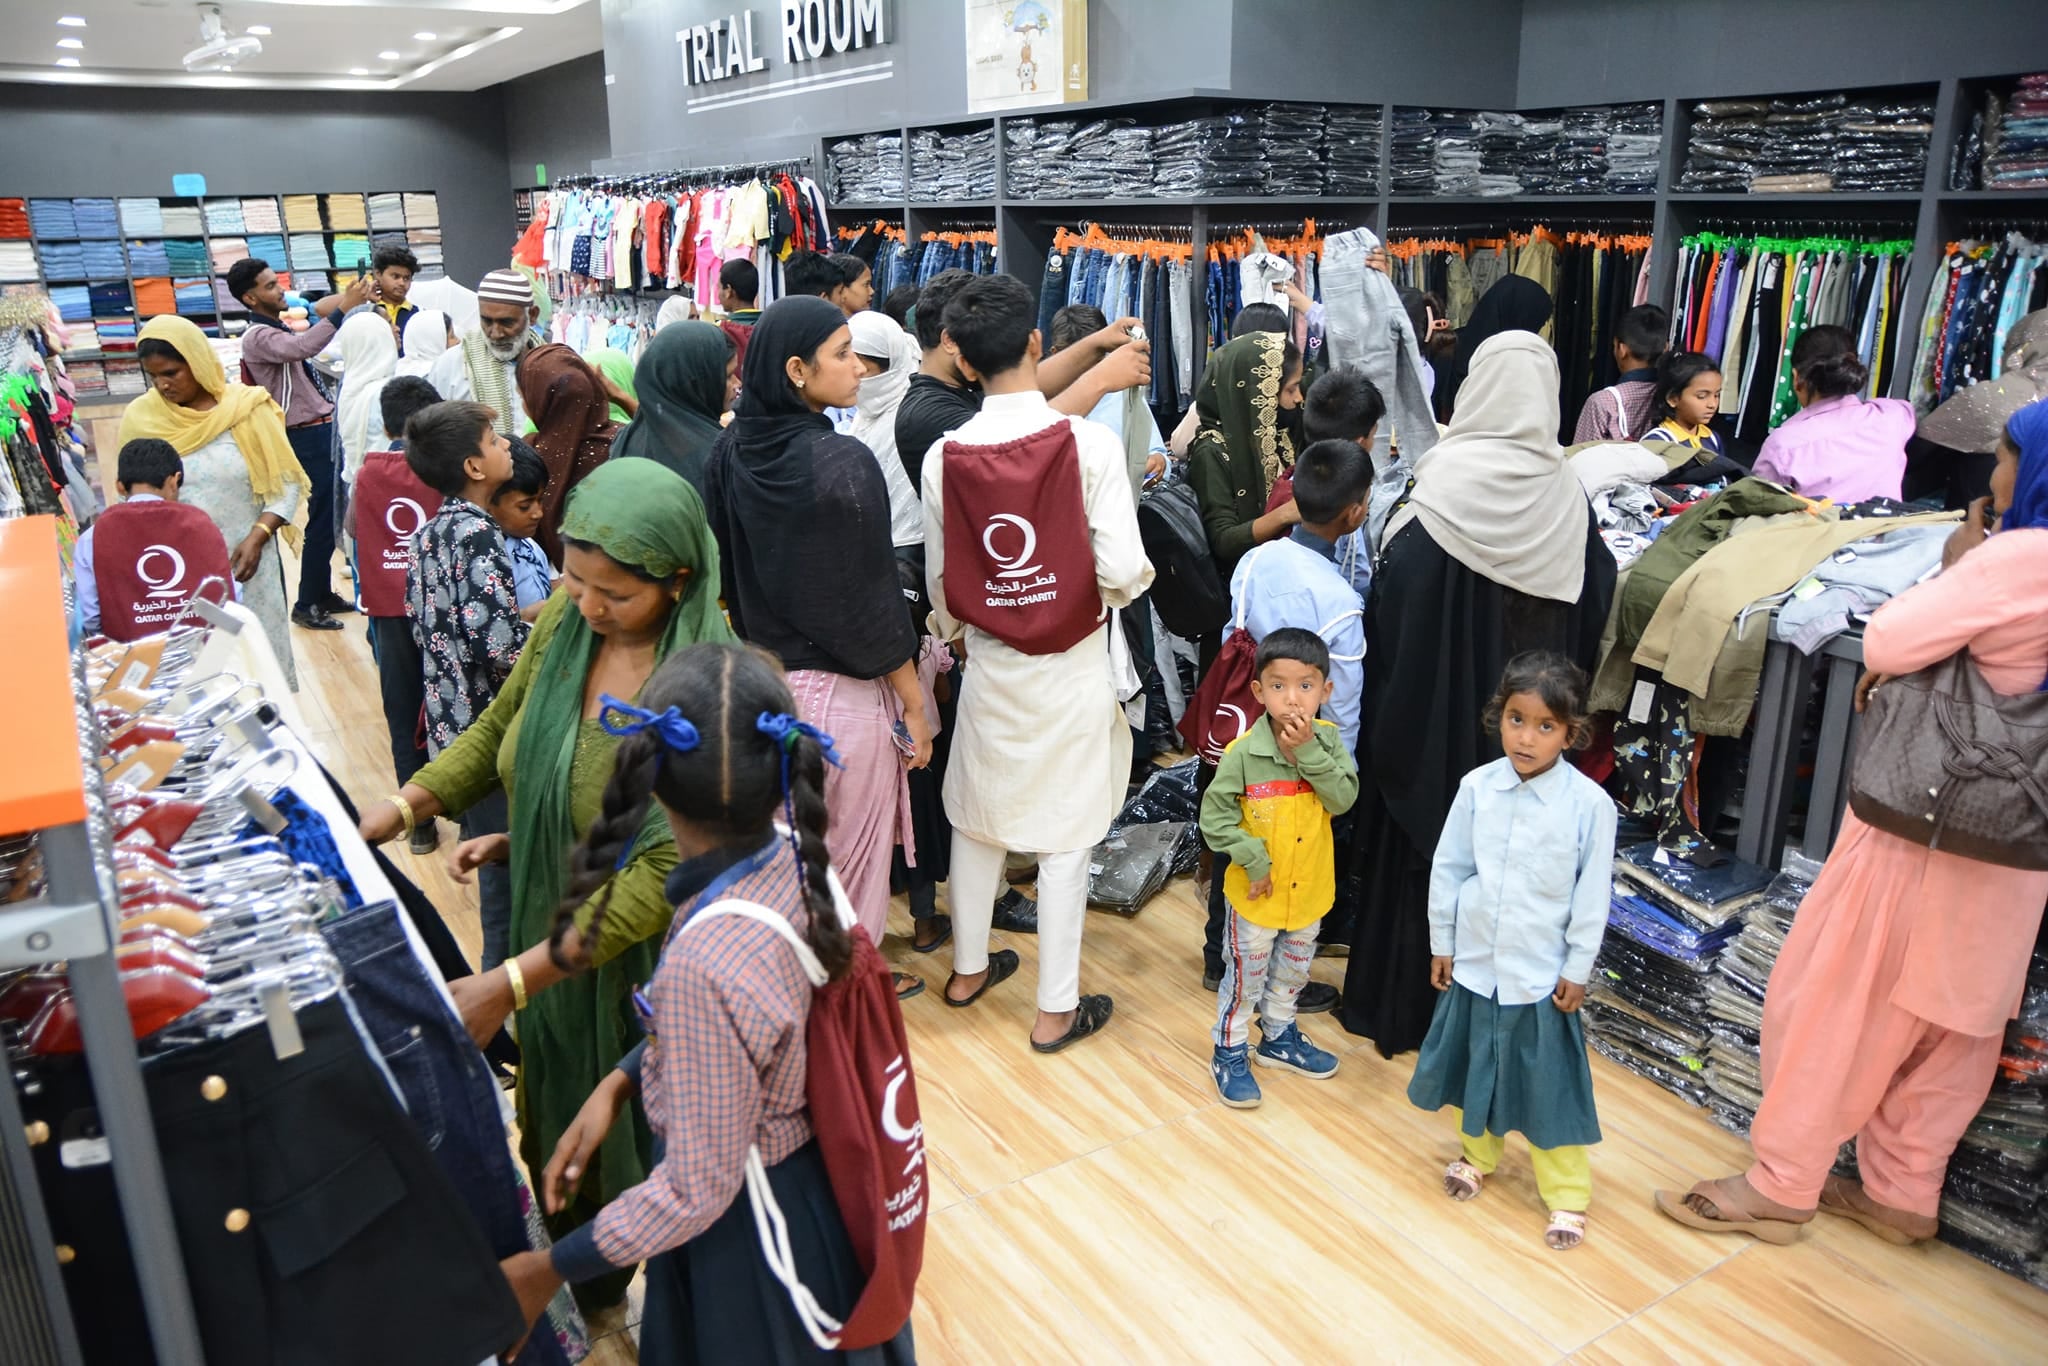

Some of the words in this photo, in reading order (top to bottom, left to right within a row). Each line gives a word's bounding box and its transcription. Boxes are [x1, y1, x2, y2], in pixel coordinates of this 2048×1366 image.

[676, 10, 764, 86] TRIAL
[780, 0, 885, 64] ROOM
[986, 598, 1016, 606] QATAR
[1017, 591, 1057, 605] CHARITY
[135, 614, 163, 623] QATAR
